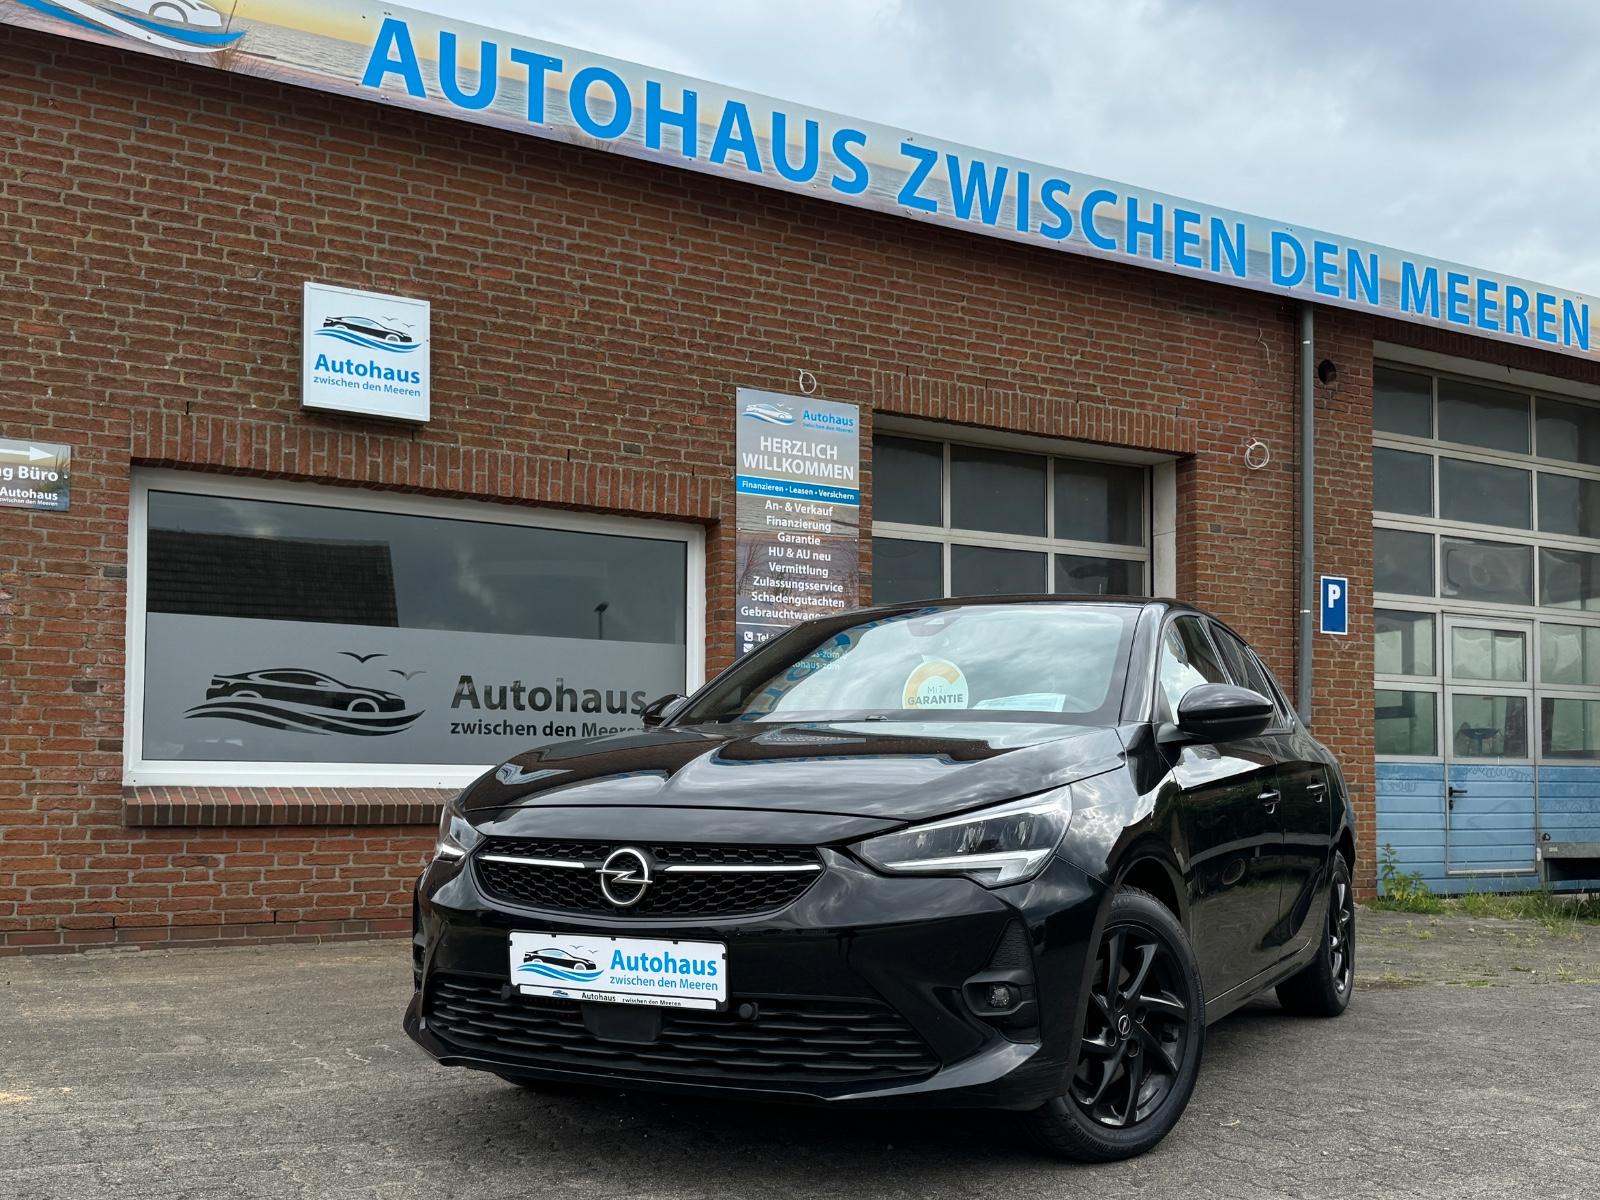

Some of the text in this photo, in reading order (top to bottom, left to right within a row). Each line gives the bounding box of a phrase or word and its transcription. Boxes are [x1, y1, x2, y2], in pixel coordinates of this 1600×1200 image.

[361, 17, 1590, 351] AUTOHAUS ZWISCHEN DEN MEEREN
[314, 353, 420, 384] Autohaus
[313, 375, 421, 397] zwischen den Meeren
[802, 410, 854, 427] Autohaus
[760, 436, 838, 460] HERZLICH
[18, 465, 59, 482] Büro
[742, 452, 854, 480] WILLKOMMEN
[0, 486, 58, 501] Autohaus
[742, 481, 855, 501] Finanzieren Leasen Versichern
[765, 500, 834, 517] An- & Verkauf
[766, 515, 832, 534] Finanzierung
[777, 532, 821, 546] Garantie
[768, 546, 831, 562] HU & AU neu
[768, 562, 829, 579] Vermittlung
[753, 576, 844, 593] Zulassungsservice
[751, 592, 845, 608] Schadengutachten
[1328, 583, 1341, 609] P
[451, 675, 647, 715] Autohaus
[907, 694, 964, 706] GARANTIE
[450, 720, 538, 738] zwischen
[542, 721, 577, 737] den
[610, 948, 718, 977] Autohaus
[609, 975, 719, 992] zwischen den Meeren
[581, 991, 617, 1002] Autohaus
